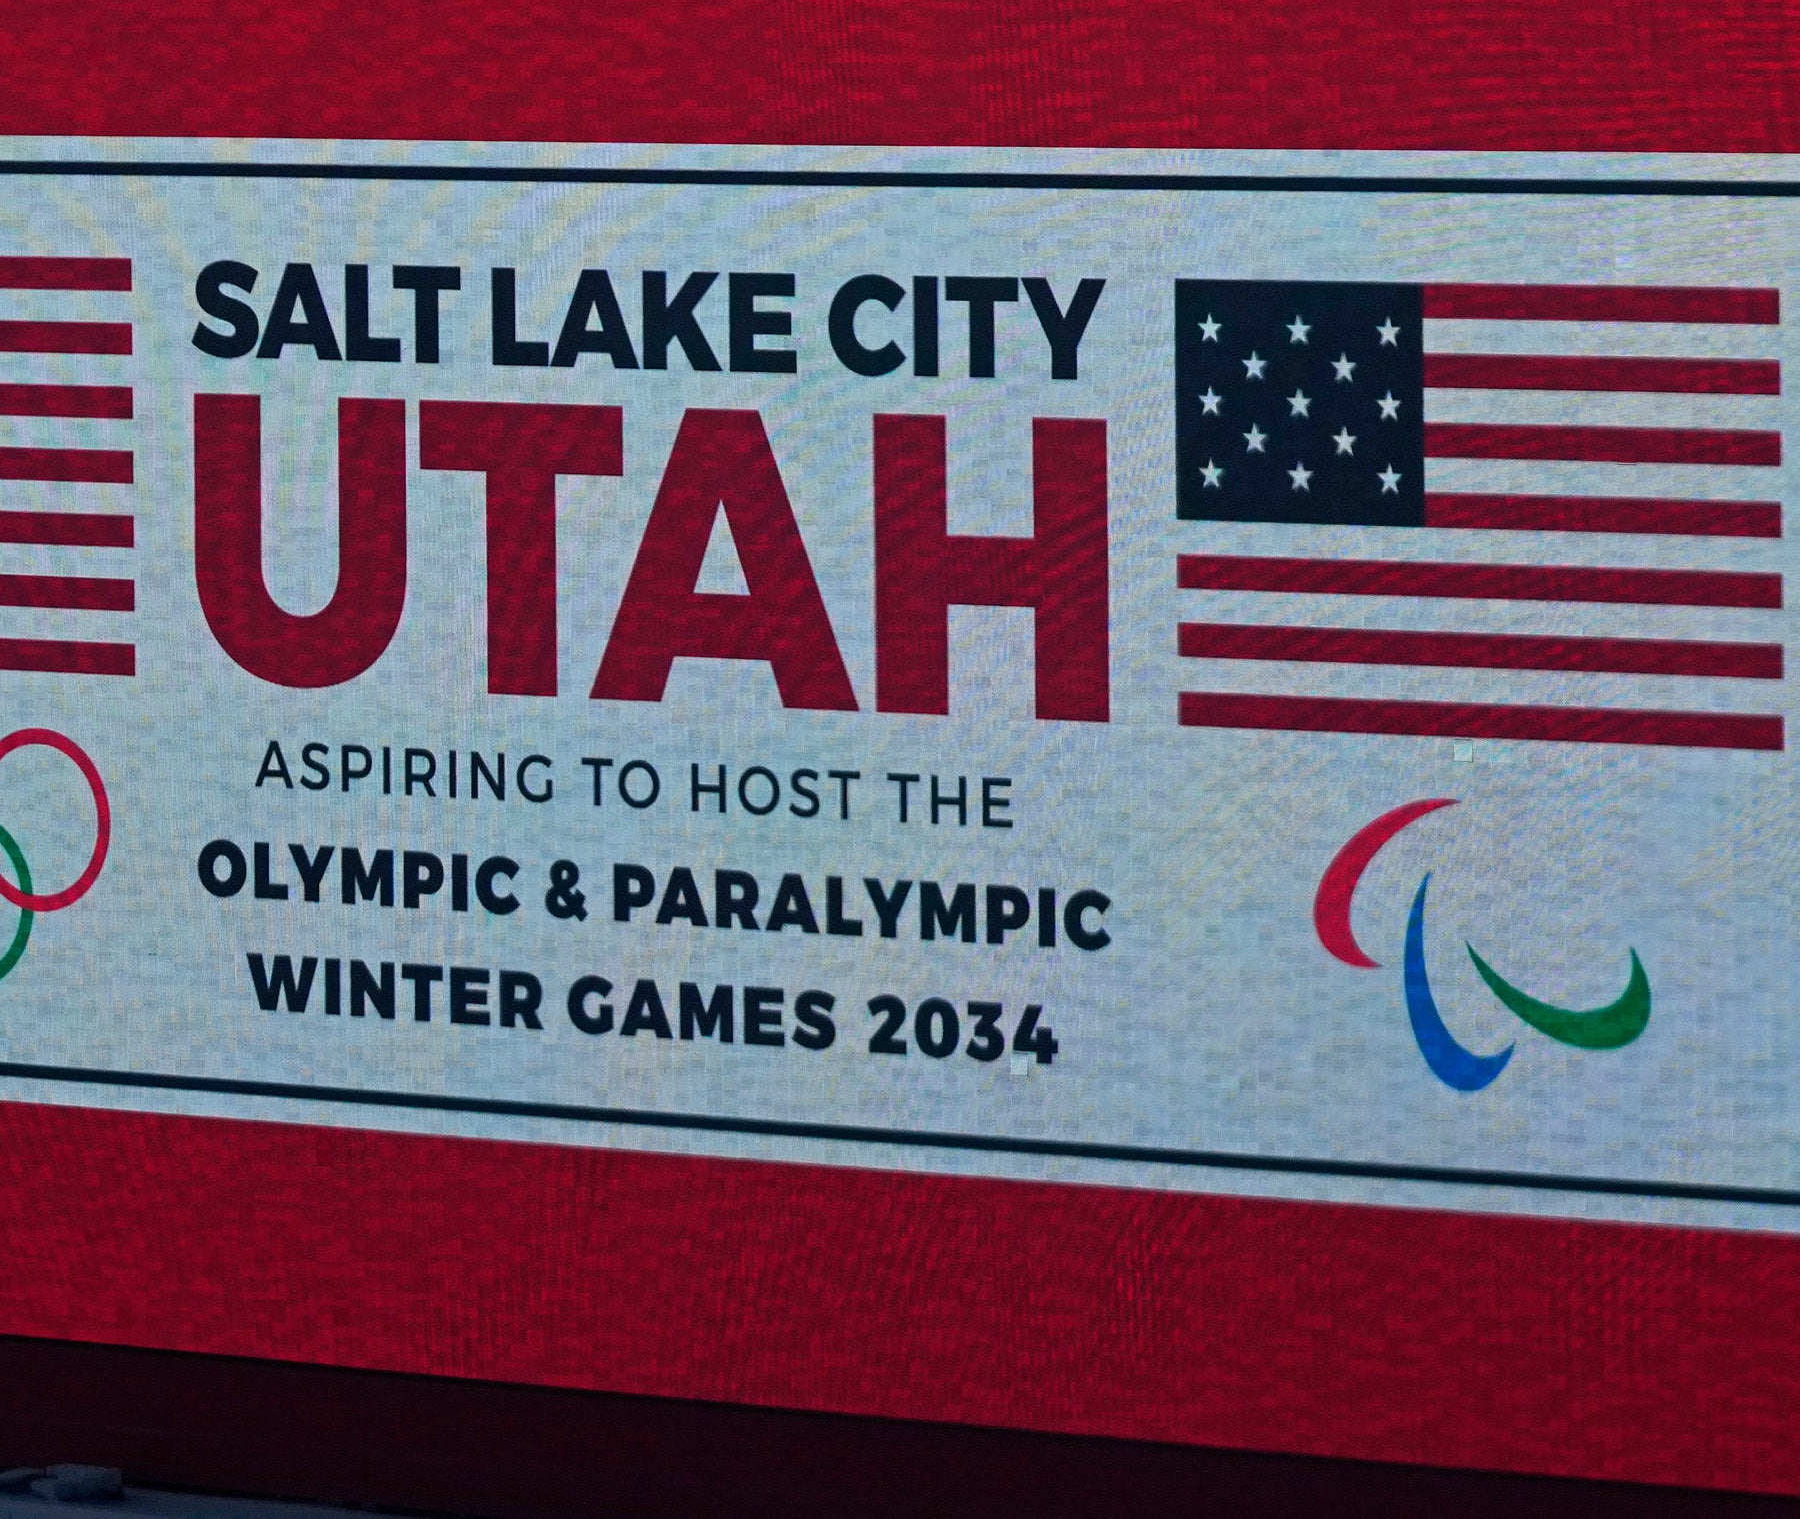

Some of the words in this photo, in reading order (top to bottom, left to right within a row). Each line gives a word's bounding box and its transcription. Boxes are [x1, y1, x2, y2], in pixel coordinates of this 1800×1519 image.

[191, 259, 462, 365] SALT
[491, 266, 799, 375] LAKE
[827, 273, 1108, 382] CITY
[193, 392, 1111, 724] UTAH
[254, 739, 555, 805] ASPIRING
[581, 756, 662, 810] TO
[687, 762, 862, 822] HOST
[885, 772, 1014, 830] THE
[196, 837, 522, 917] OLYMPIC
[544, 858, 589, 923] &
[612, 861, 1113, 953] PARALYMPIC
[244, 951, 545, 1031] WINTER
[566, 973, 838, 1053] GAMES
[866, 993, 1060, 1067] 2034
